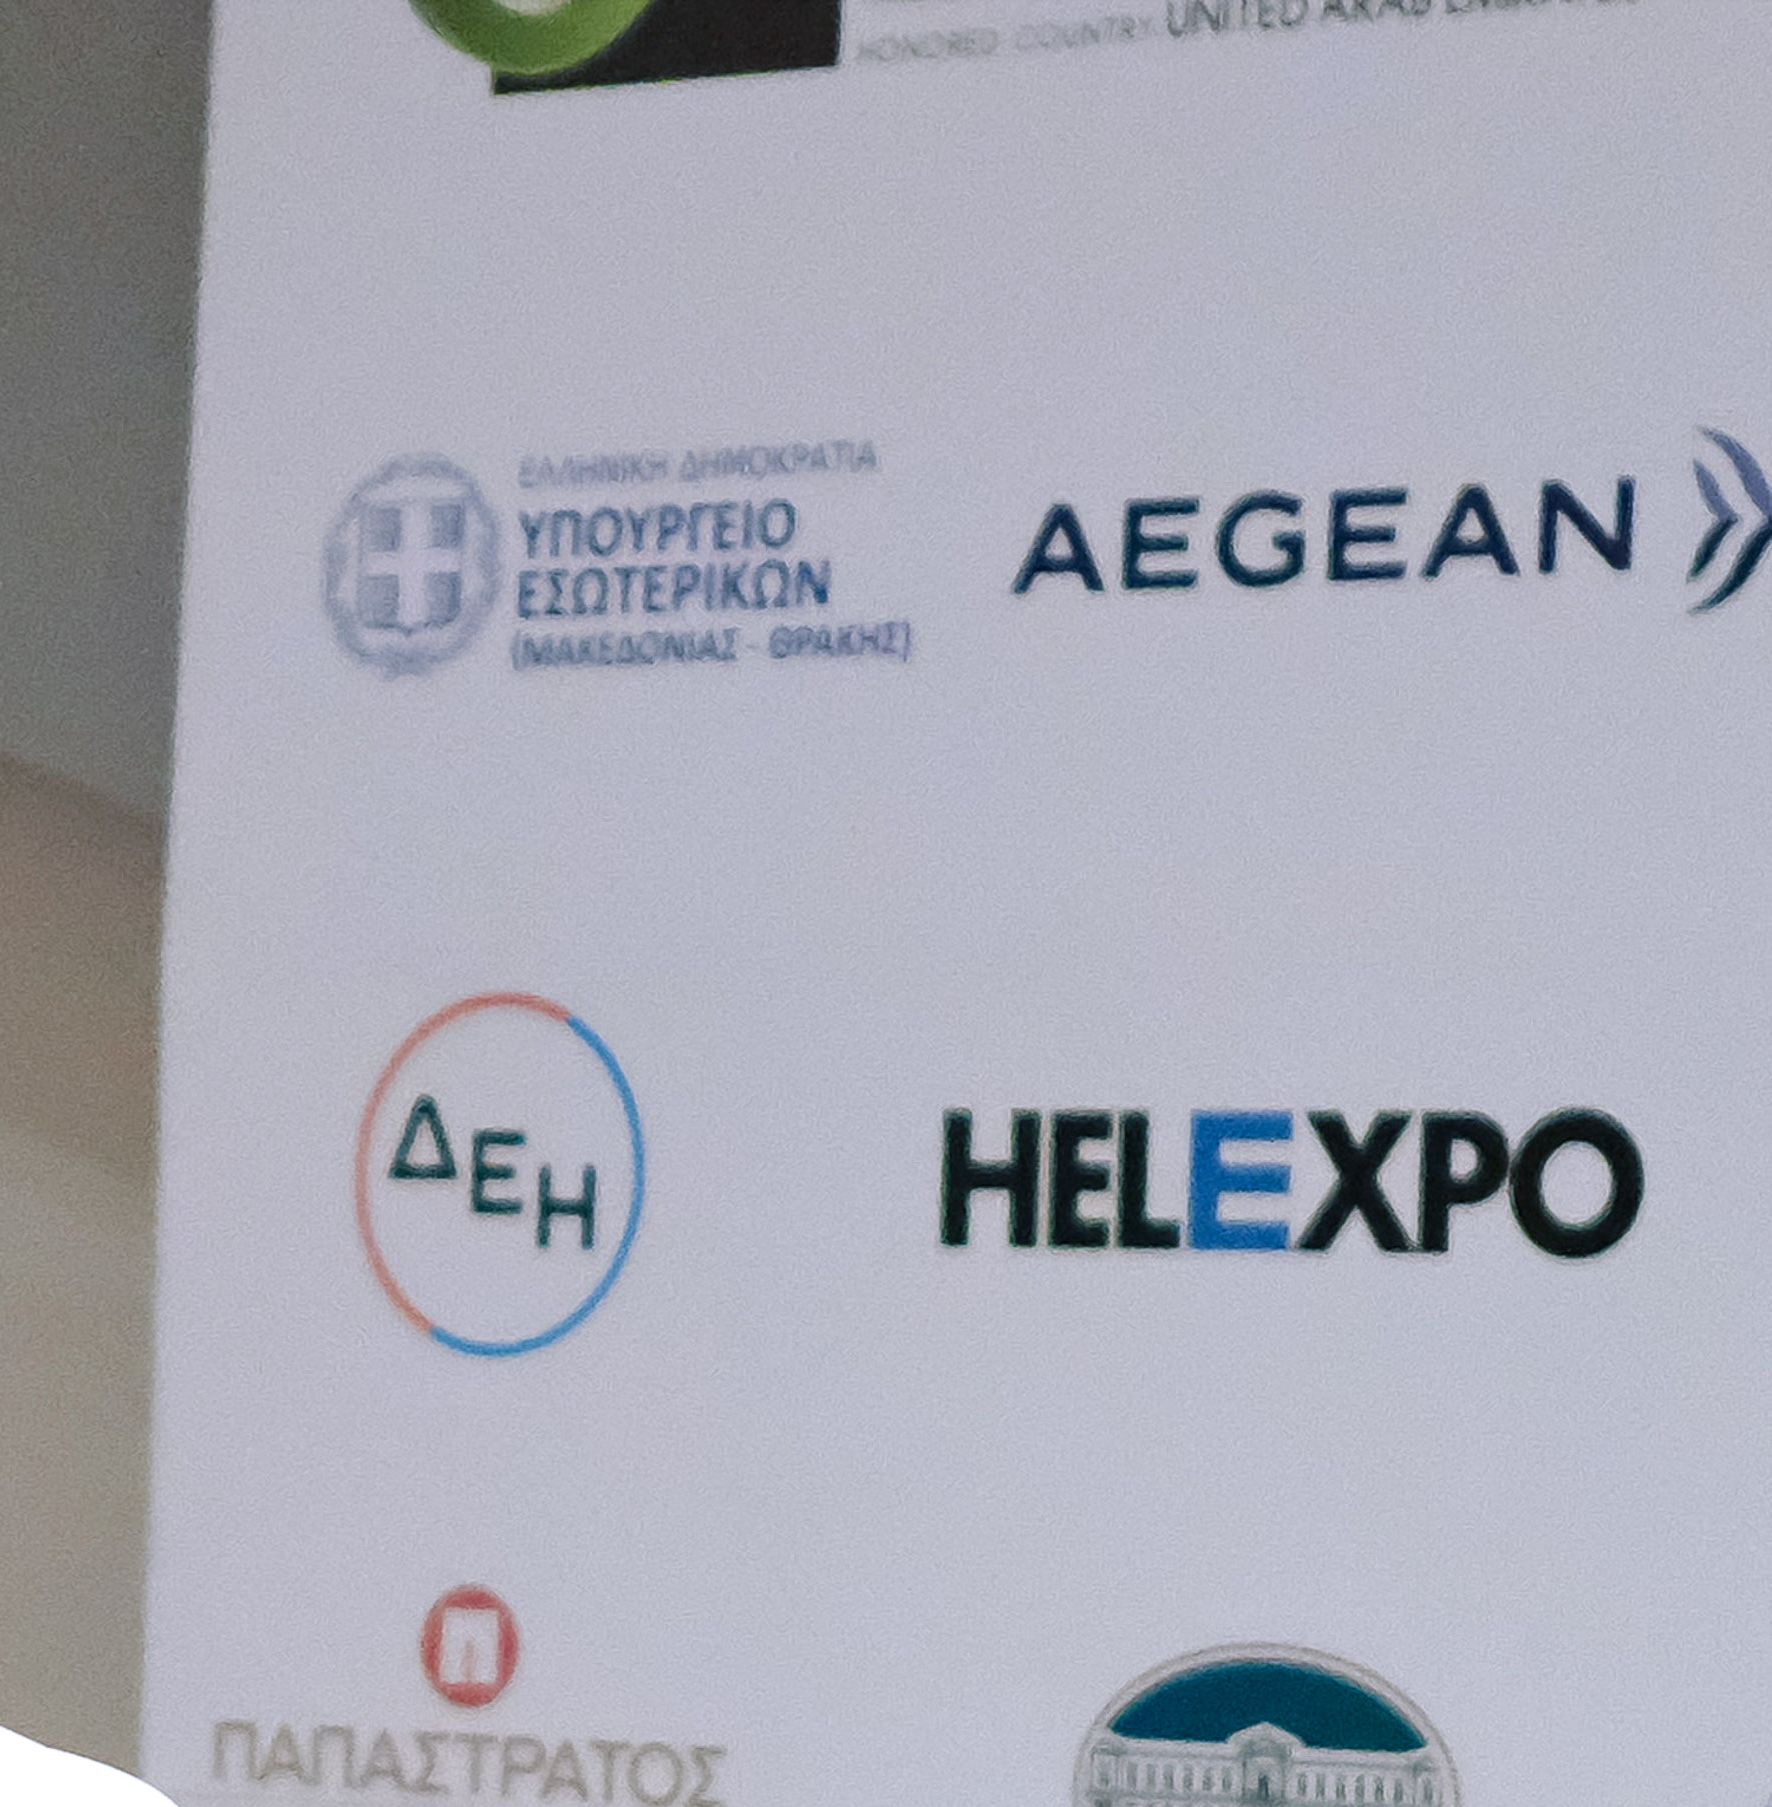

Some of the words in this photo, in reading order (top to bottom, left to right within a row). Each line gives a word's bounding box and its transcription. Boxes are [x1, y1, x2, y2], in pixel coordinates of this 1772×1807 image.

[517, 498, 798, 559] ΥΠΟΥΡΓΕΙΟ
[517, 558, 832, 619] ΕΣΩΤΕΡΙΚΩΝ
[1011, 474, 1636, 595] AEGEAN
[389, 1094, 596, 1251] ΔΕΗ
[937, 1106, 1645, 1259] HELEXPO
